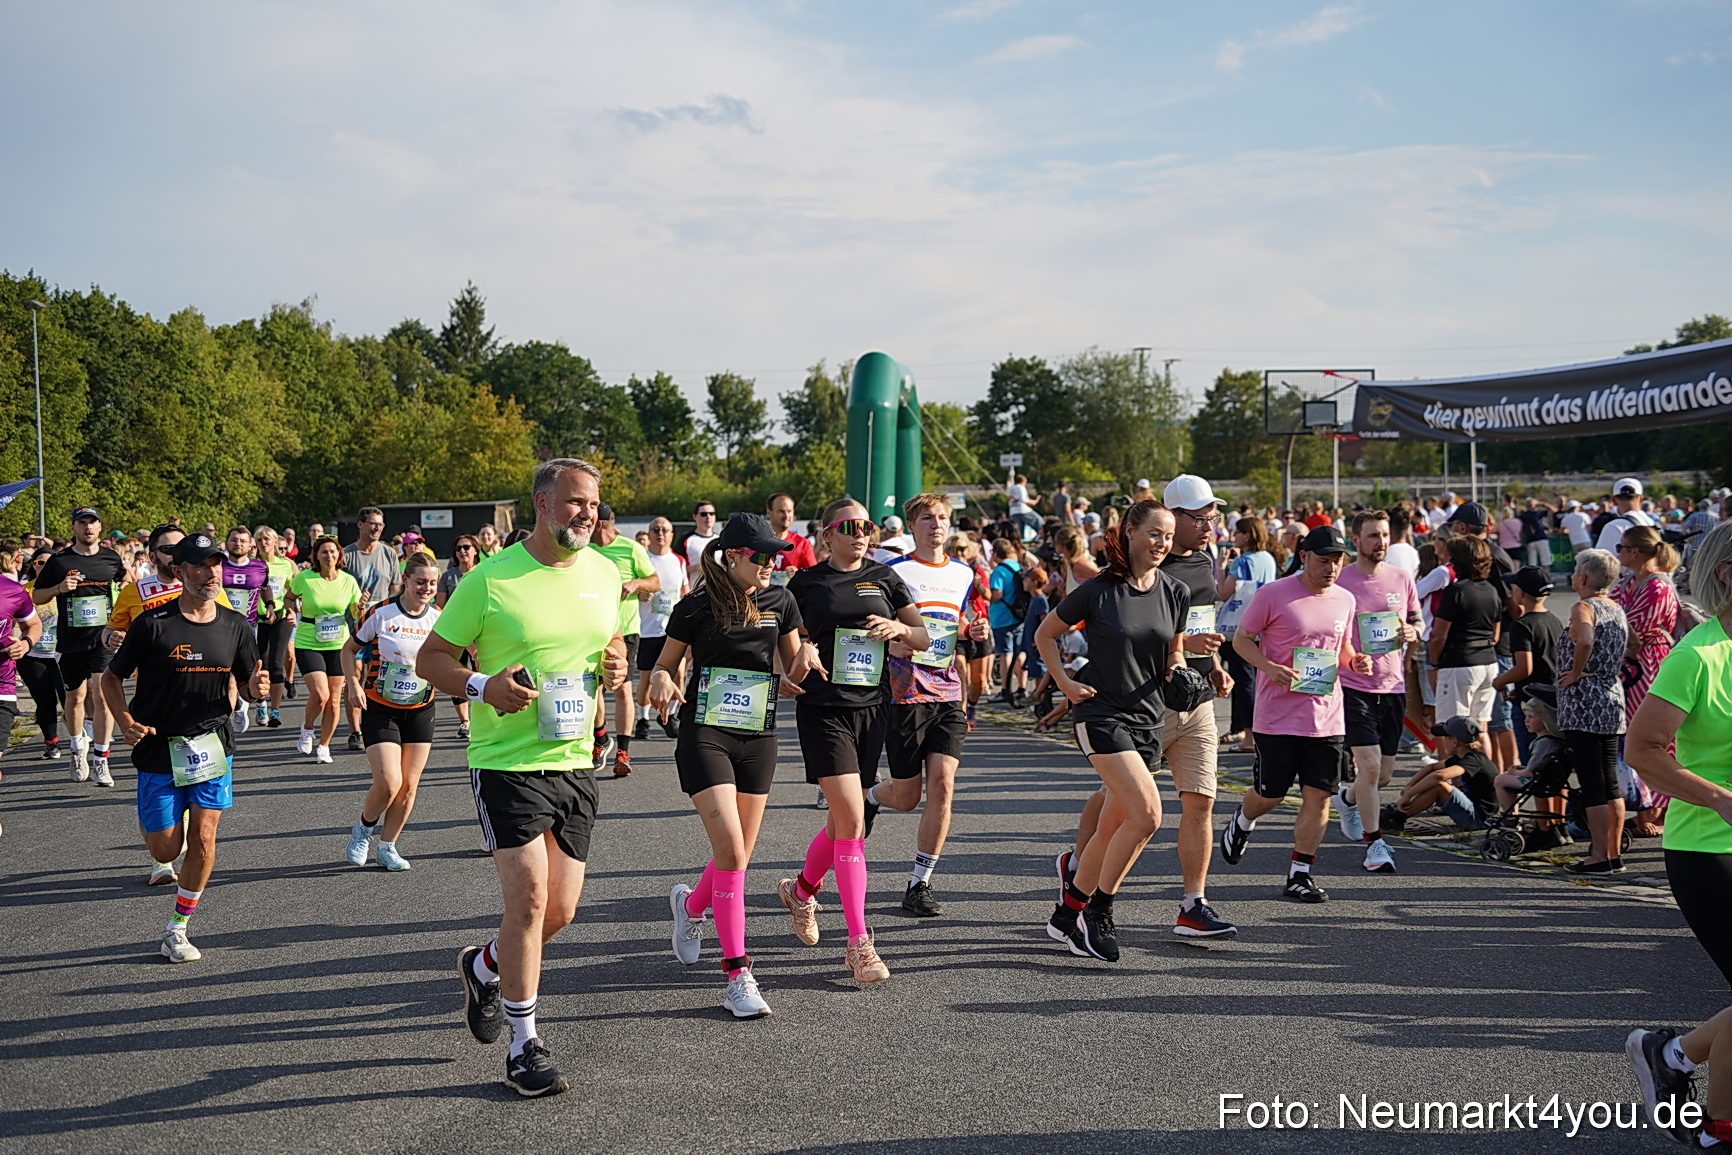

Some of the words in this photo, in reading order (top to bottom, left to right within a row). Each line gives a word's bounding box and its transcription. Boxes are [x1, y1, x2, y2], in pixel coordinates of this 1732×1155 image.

[1422, 401, 1462, 430] Hier
[1461, 396, 1541, 438] gewinnt
[1540, 393, 1583, 425] das
[1585, 371, 1732, 422] Miteinande
[82, 608, 97, 616] 196
[321, 624, 339, 632] 1026
[1371, 629, 1389, 638] 147
[168, 644, 192, 660] 45
[847, 652, 873, 665] 246
[1305, 666, 1323, 677] 134
[393, 680, 418, 690] 1299
[722, 693, 751, 707] 253
[554, 700, 584, 714] 1015
[186, 752, 209, 765] 189
